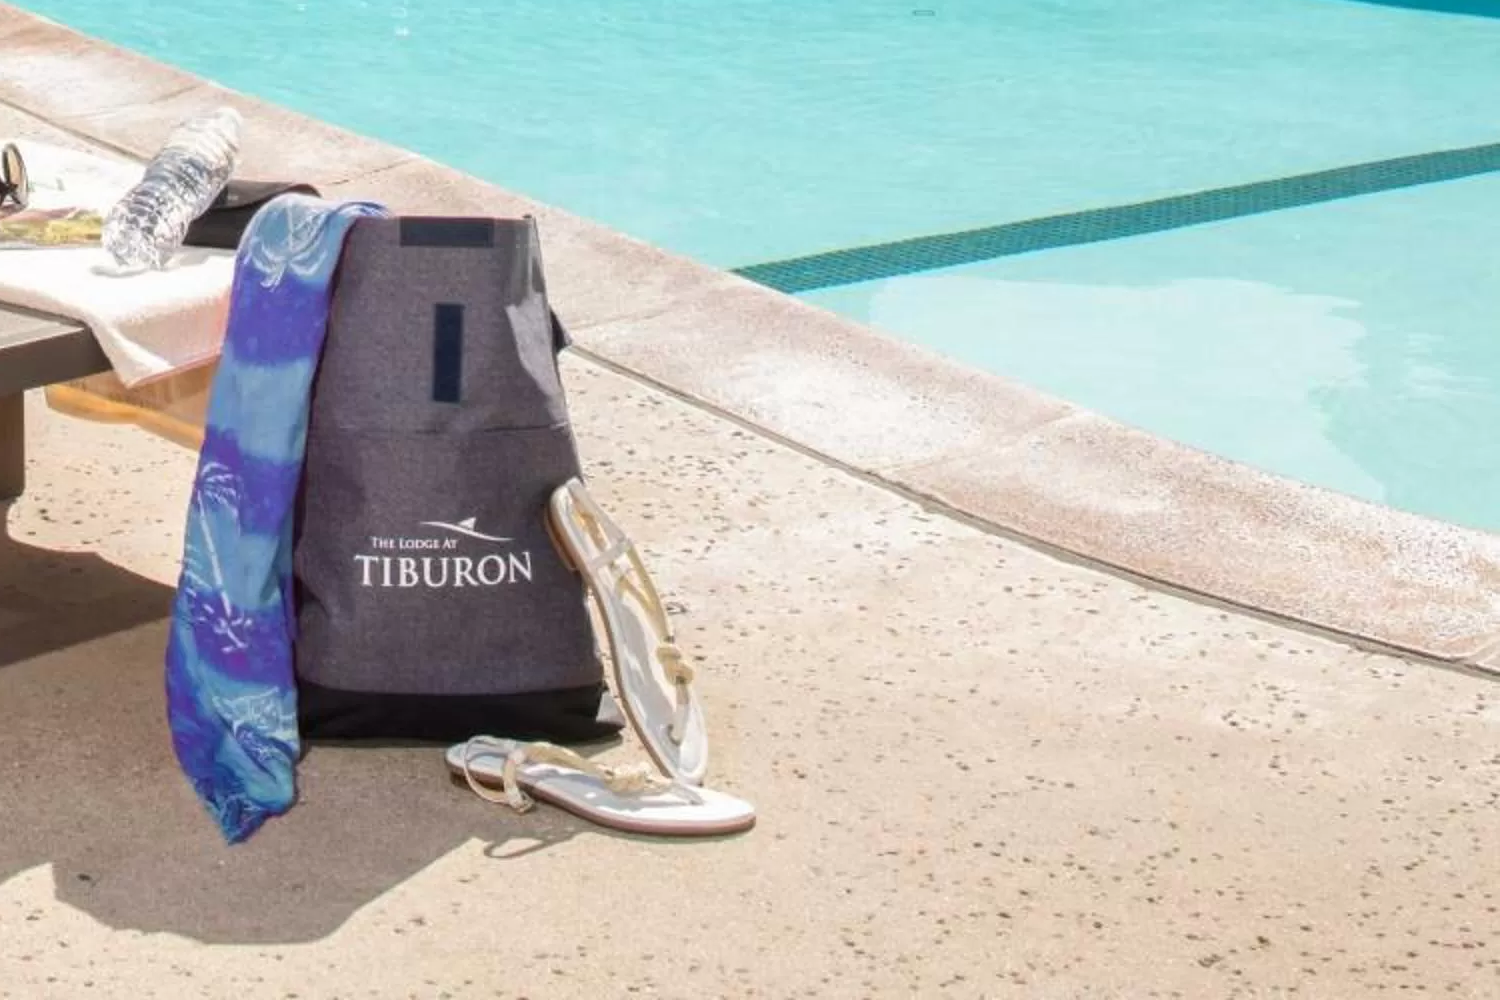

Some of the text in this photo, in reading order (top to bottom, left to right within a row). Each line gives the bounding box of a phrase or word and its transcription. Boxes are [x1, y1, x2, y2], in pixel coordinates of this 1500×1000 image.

[371, 536, 458, 549] THE LODGE AT
[354, 551, 532, 588] TIBURON
